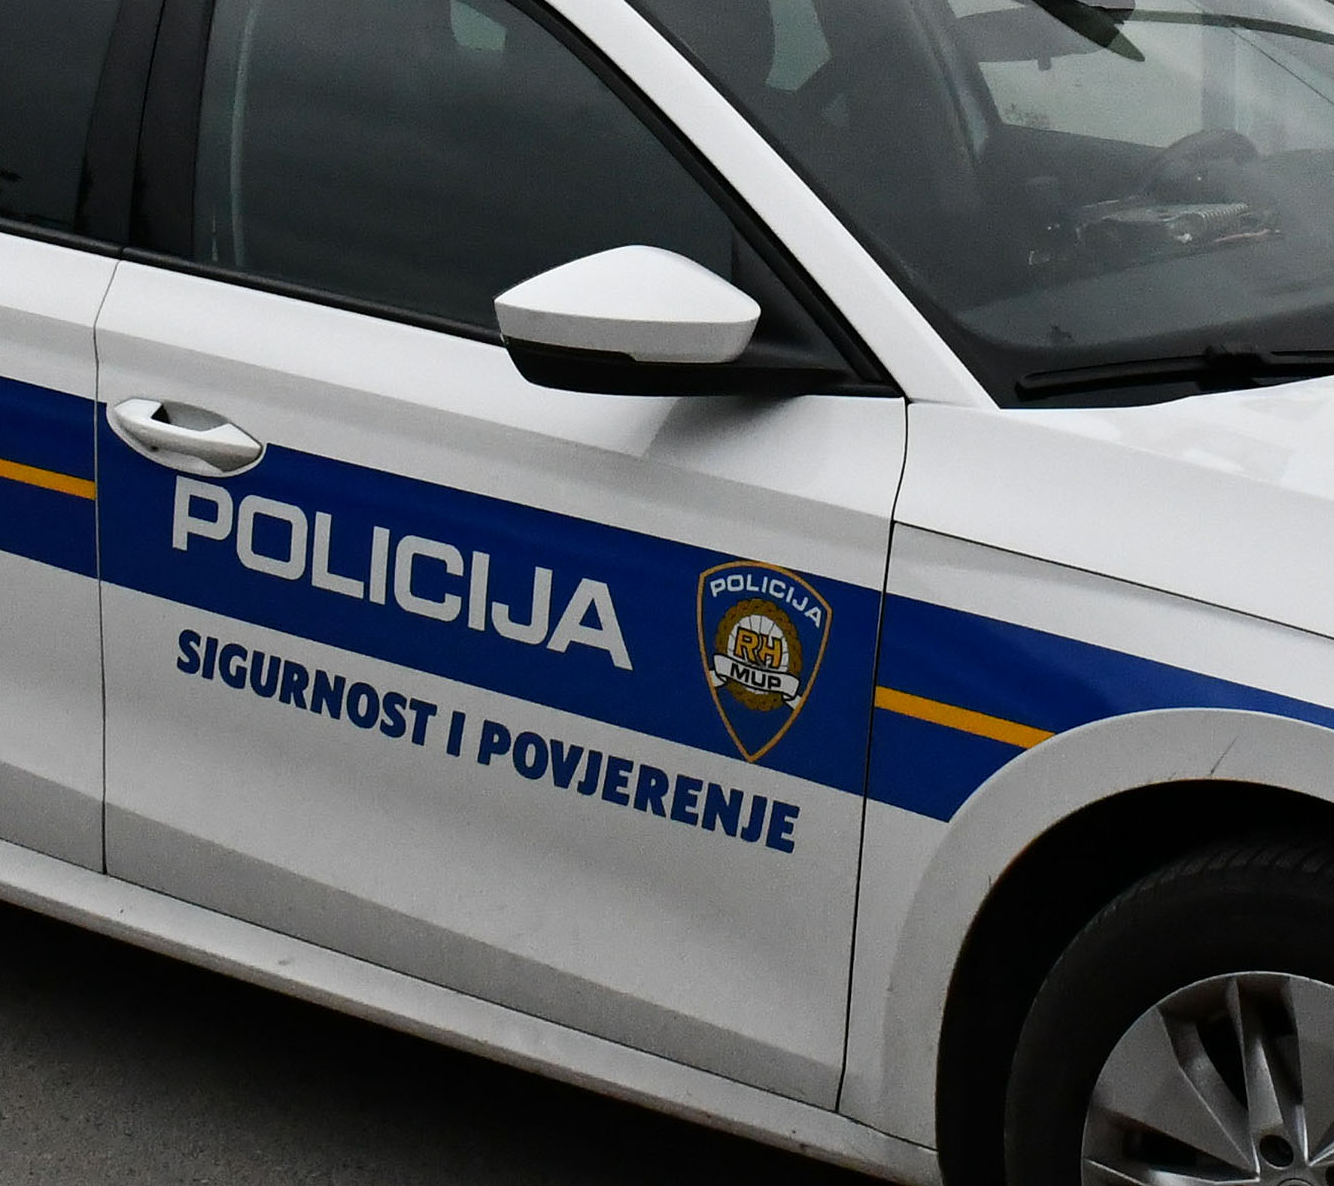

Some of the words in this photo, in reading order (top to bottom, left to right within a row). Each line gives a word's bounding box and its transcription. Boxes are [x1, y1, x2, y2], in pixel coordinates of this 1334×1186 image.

[172, 475, 634, 671] POLICIJA
[709, 574, 822, 629] POLICIJA
[734, 626, 783, 669] RH
[730, 663, 782, 690] MUP
[176, 629, 438, 746] SIGURNOST
[446, 710, 466, 757] I
[477, 718, 802, 855] POVJERENJE
